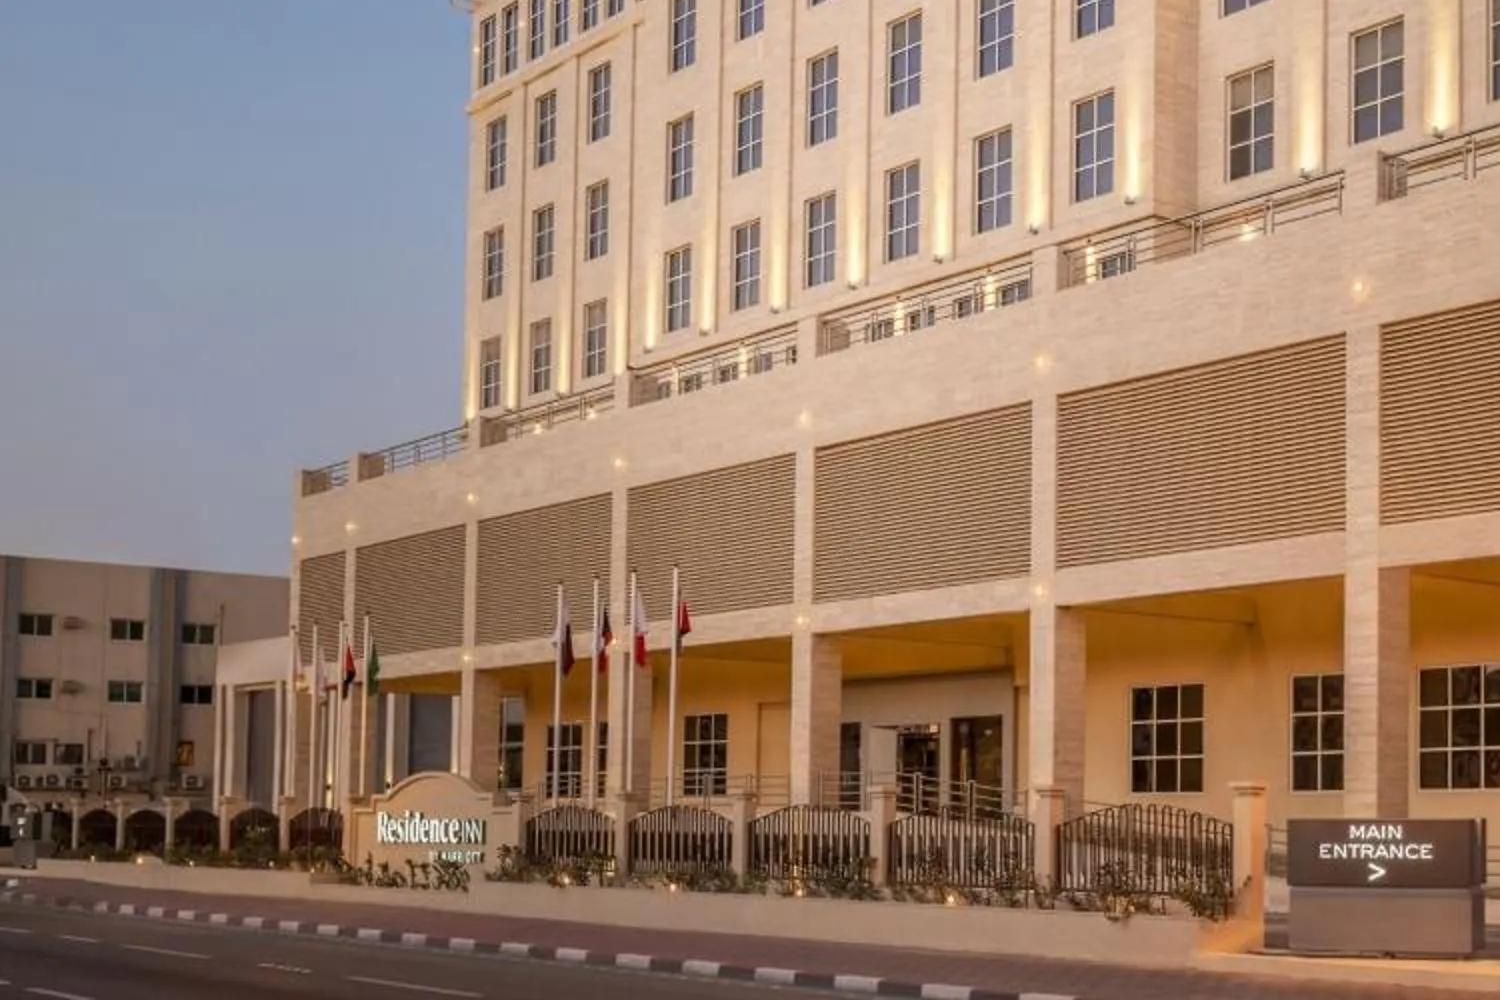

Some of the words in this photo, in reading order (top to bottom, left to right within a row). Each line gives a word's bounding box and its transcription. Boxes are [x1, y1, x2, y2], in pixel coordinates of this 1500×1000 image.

[377, 810, 460, 844] Residence
[1349, 825, 1403, 840] MAIN
[1319, 843, 1434, 859] ENTRANCE
